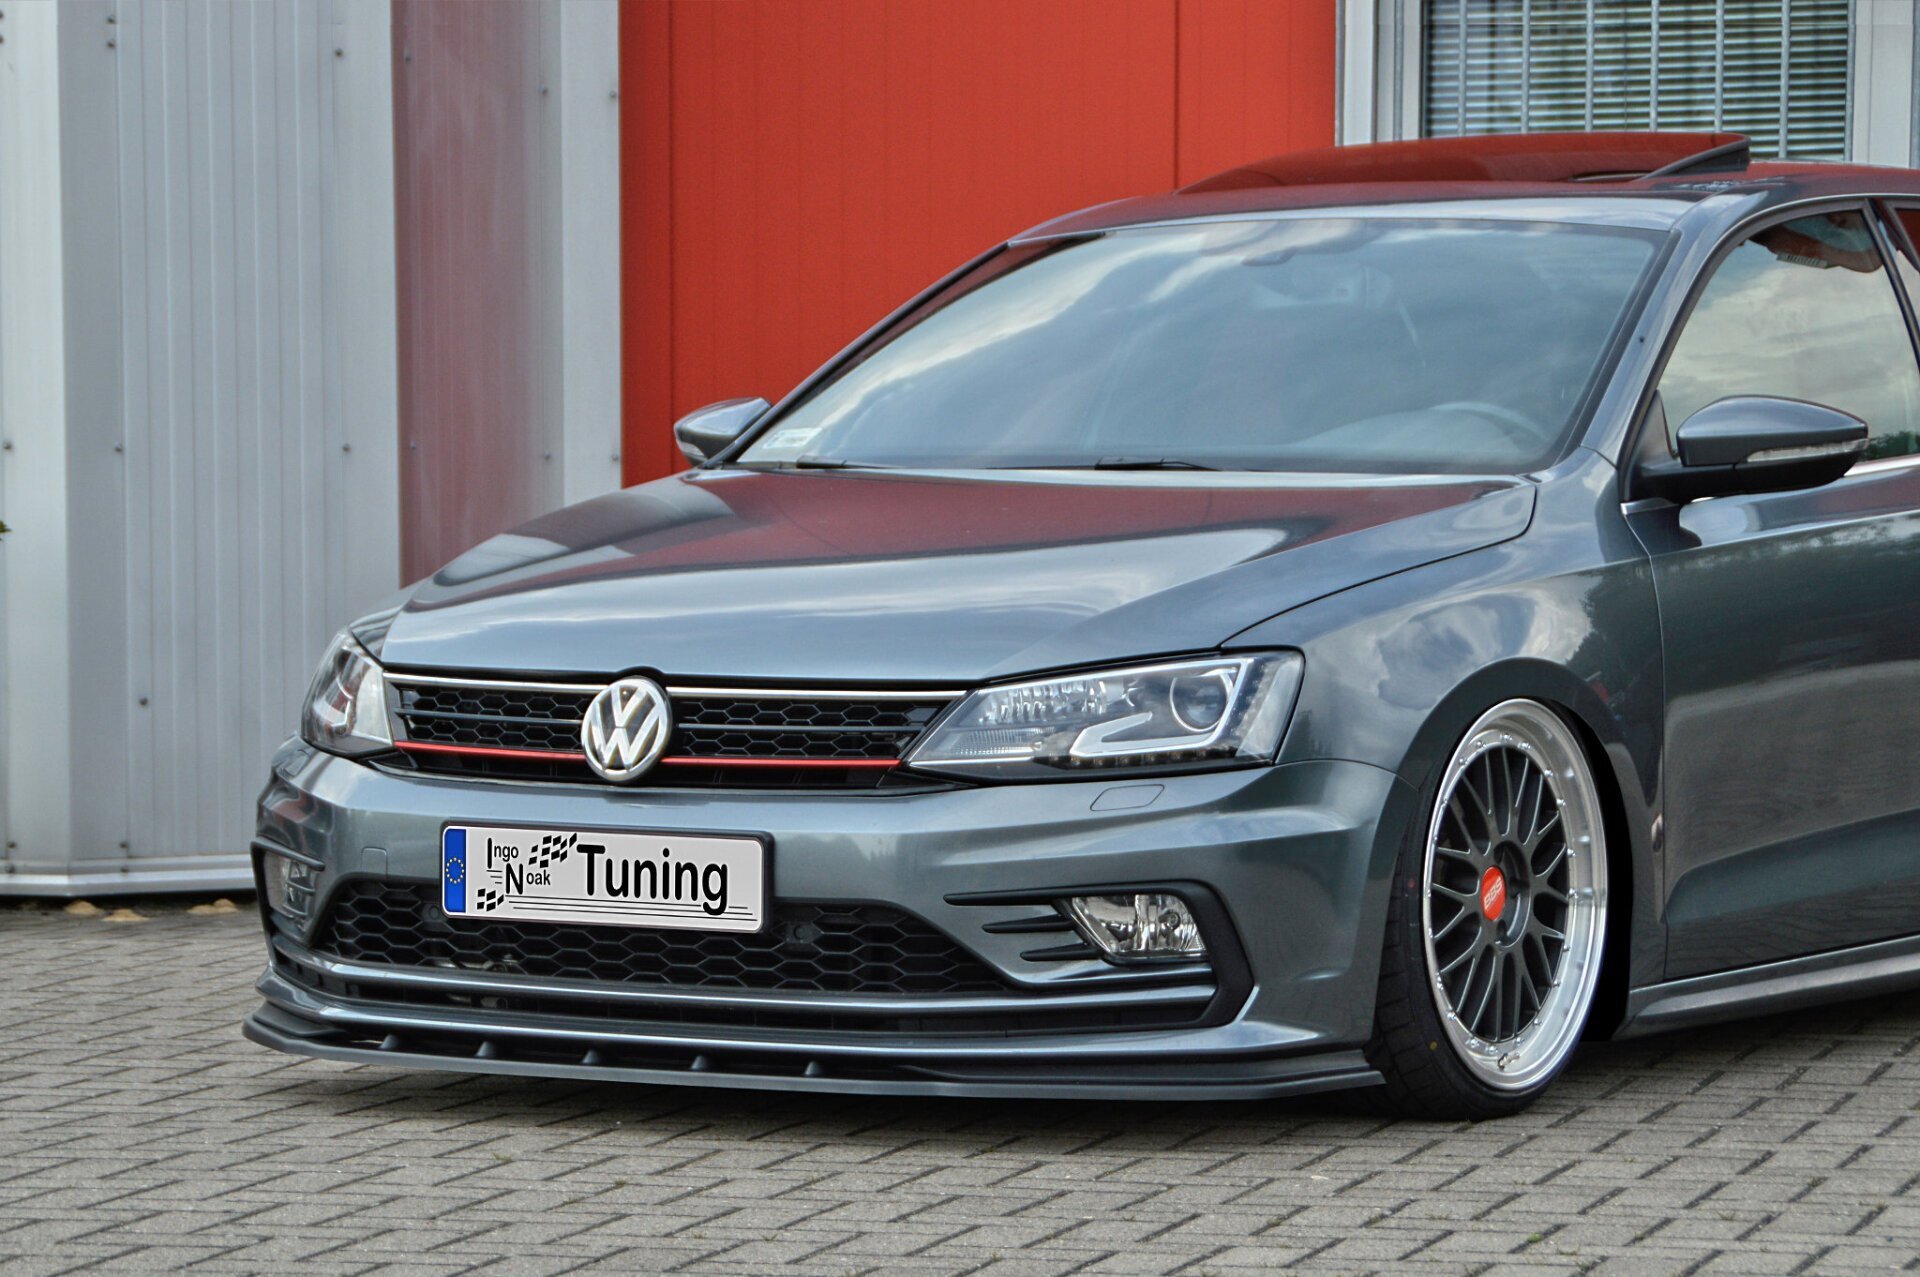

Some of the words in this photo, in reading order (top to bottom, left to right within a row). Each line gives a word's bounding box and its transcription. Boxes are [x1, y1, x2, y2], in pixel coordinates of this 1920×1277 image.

[585, 680, 665, 774] VW
[487, 837, 519, 869] Ingo
[505, 862, 551, 895] Noak
[576, 844, 728, 916] Tuning
